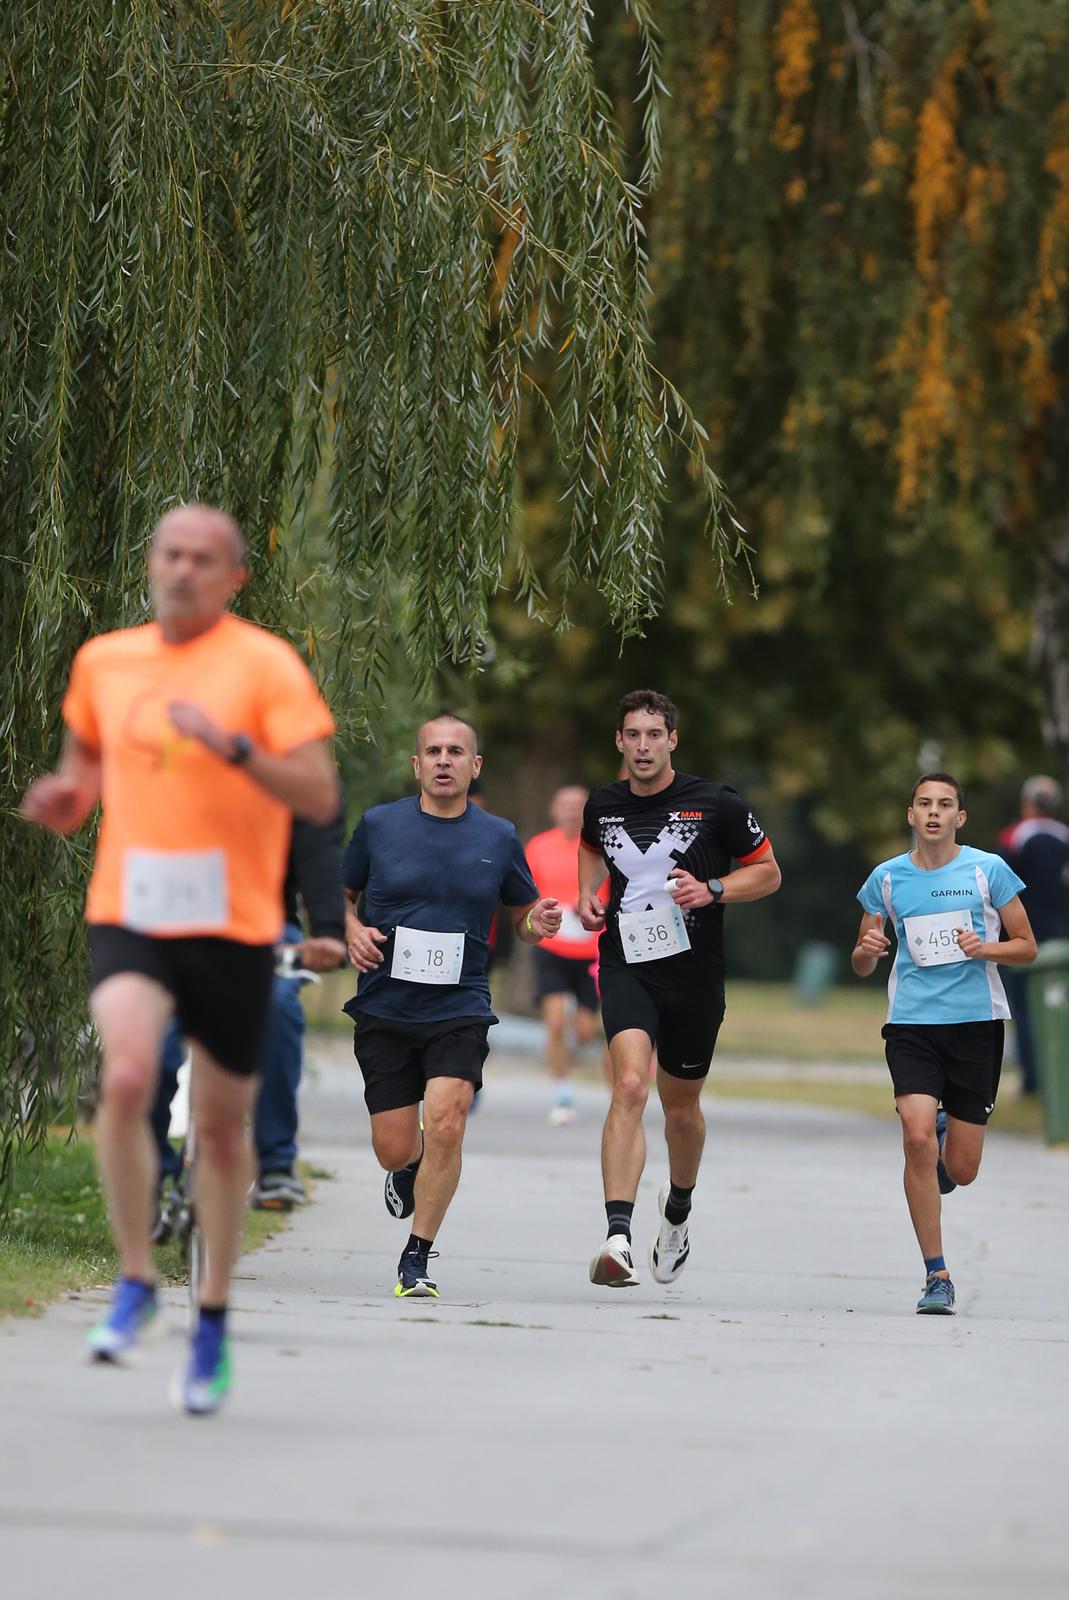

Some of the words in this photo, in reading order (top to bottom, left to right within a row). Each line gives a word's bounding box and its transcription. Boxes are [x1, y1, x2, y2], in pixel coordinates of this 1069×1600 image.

[931, 889, 973, 898] GARMIN
[644, 924, 668, 943] 36
[928, 928, 959, 948] 458
[426, 949, 444, 967] 18
